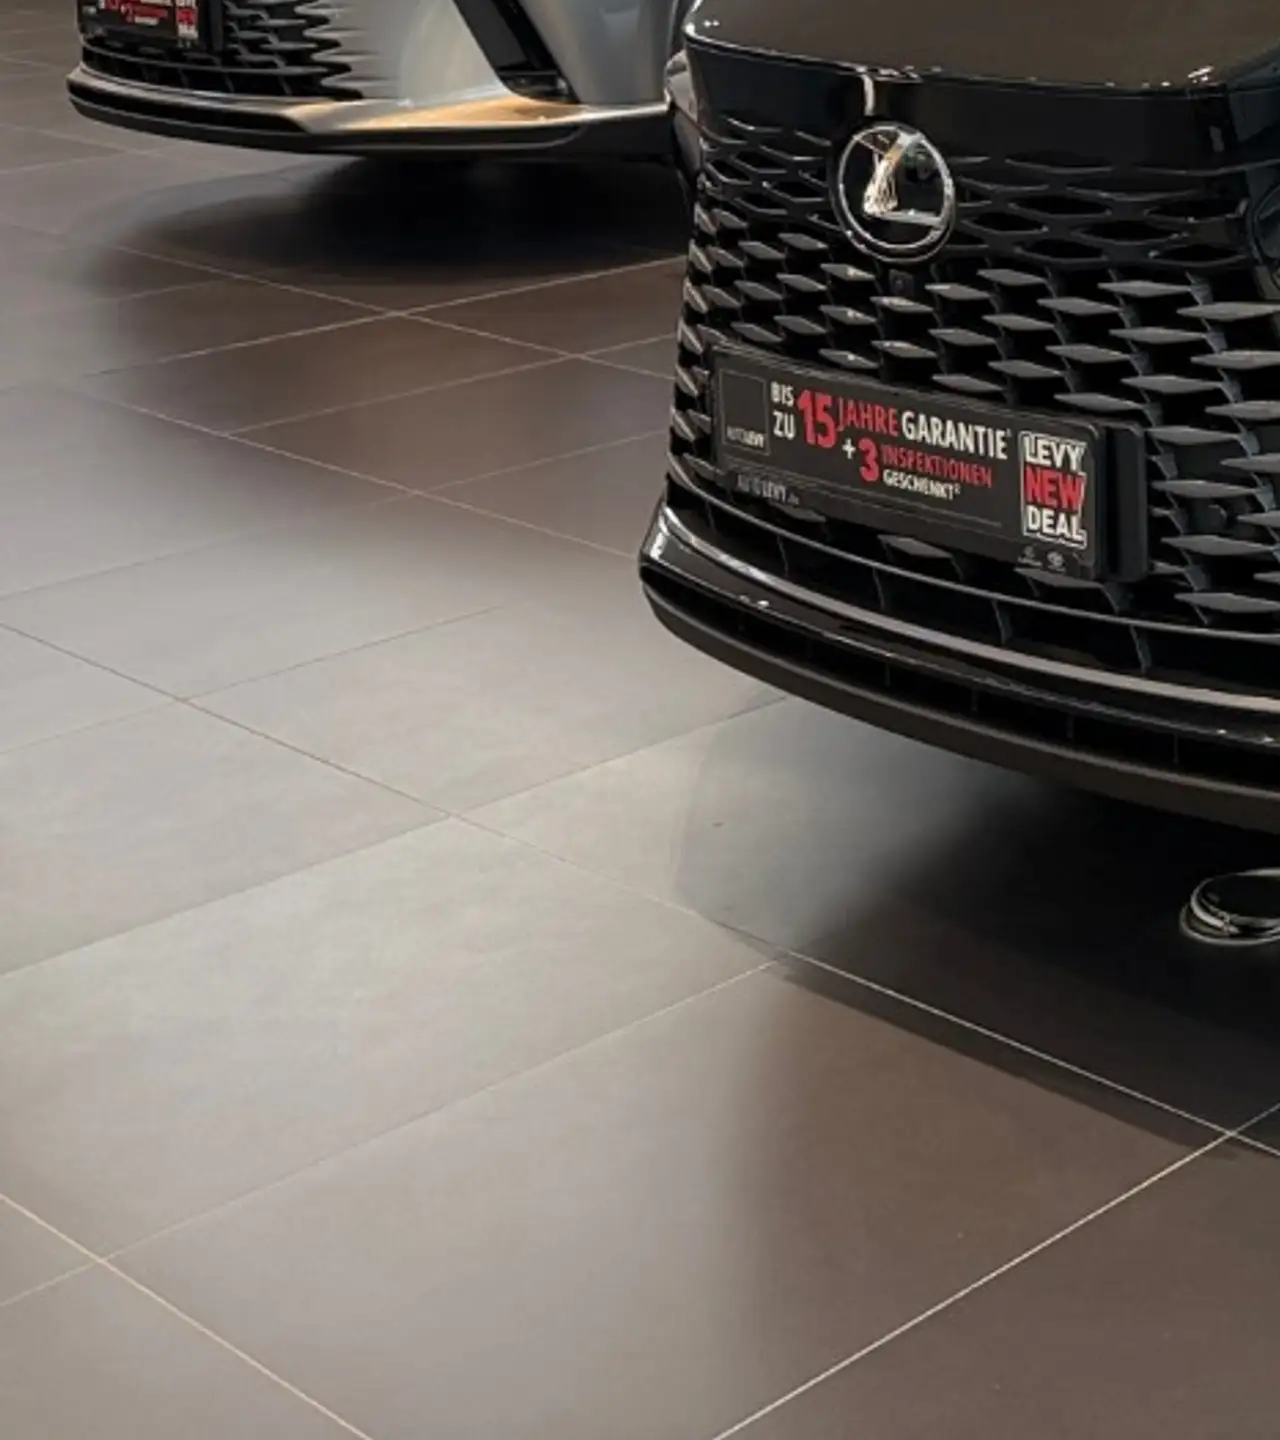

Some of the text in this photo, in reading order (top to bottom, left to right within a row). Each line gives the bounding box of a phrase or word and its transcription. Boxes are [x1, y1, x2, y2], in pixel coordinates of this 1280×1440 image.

[770, 380, 794, 407] BIS
[772, 410, 797, 441] ZU
[796, 388, 837, 449] 15
[835, 396, 899, 437] JAHRE
[857, 437, 880, 482] 3
[881, 444, 993, 489] INSPEKTIONEN
[1023, 436, 1086, 471] LEVY
[1024, 466, 1087, 512] NEW
[1026, 505, 1085, 540] DEAL
